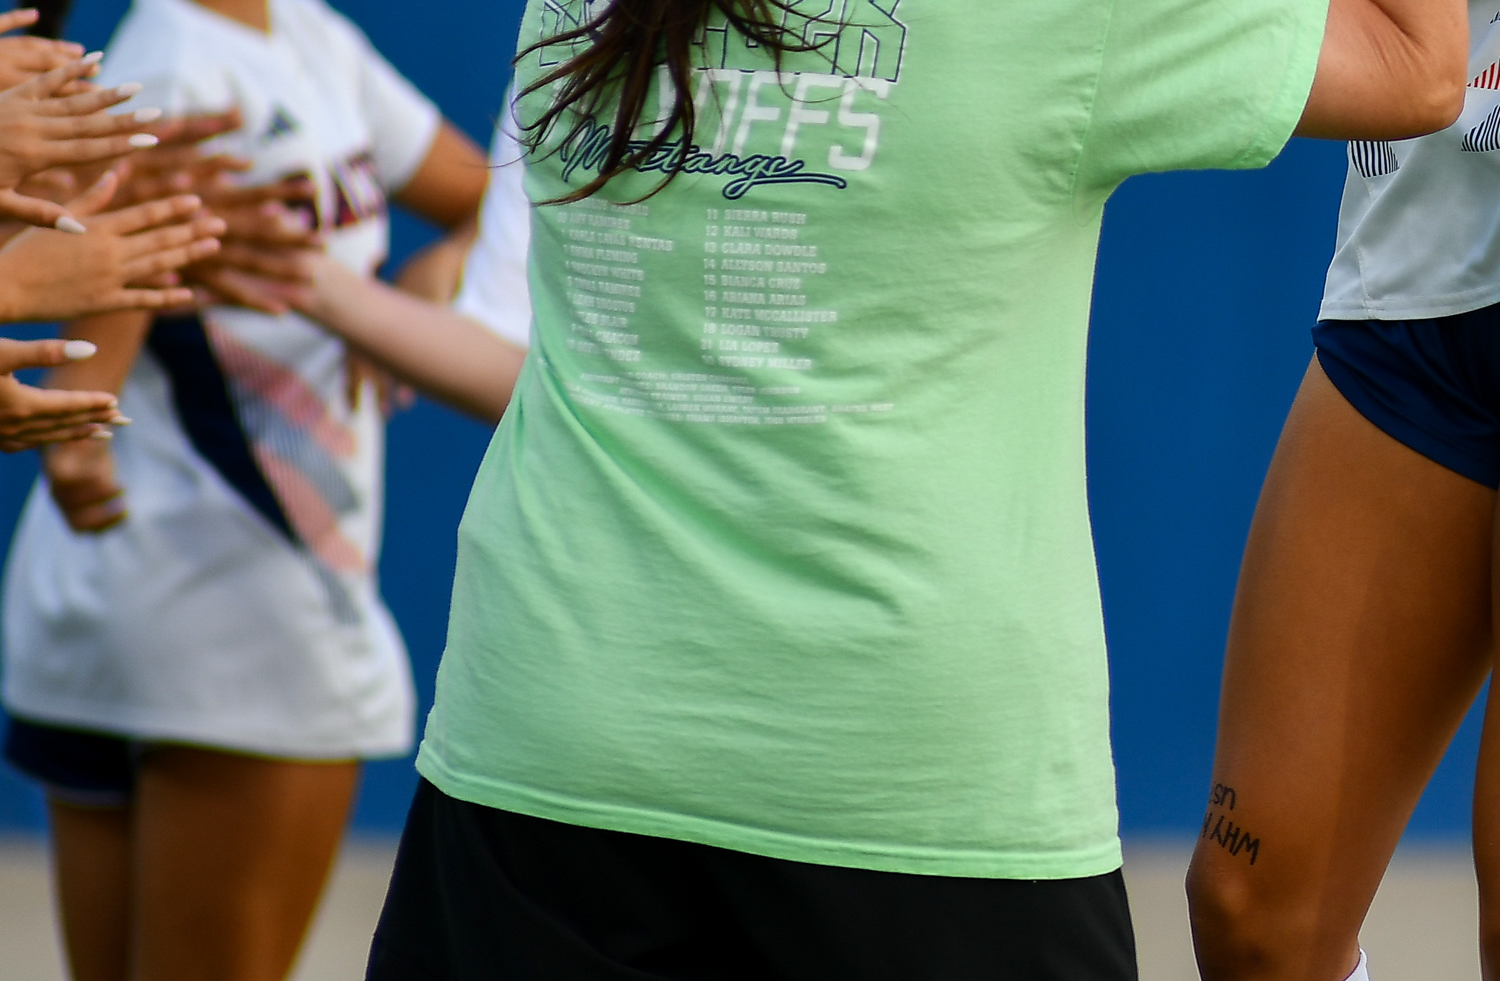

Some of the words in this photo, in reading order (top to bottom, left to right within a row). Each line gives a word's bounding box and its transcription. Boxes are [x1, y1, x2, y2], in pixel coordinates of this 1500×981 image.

[560, 116, 846, 200] Mtangs
[706, 225, 718, 237] 12
[703, 258, 716, 270] 14
